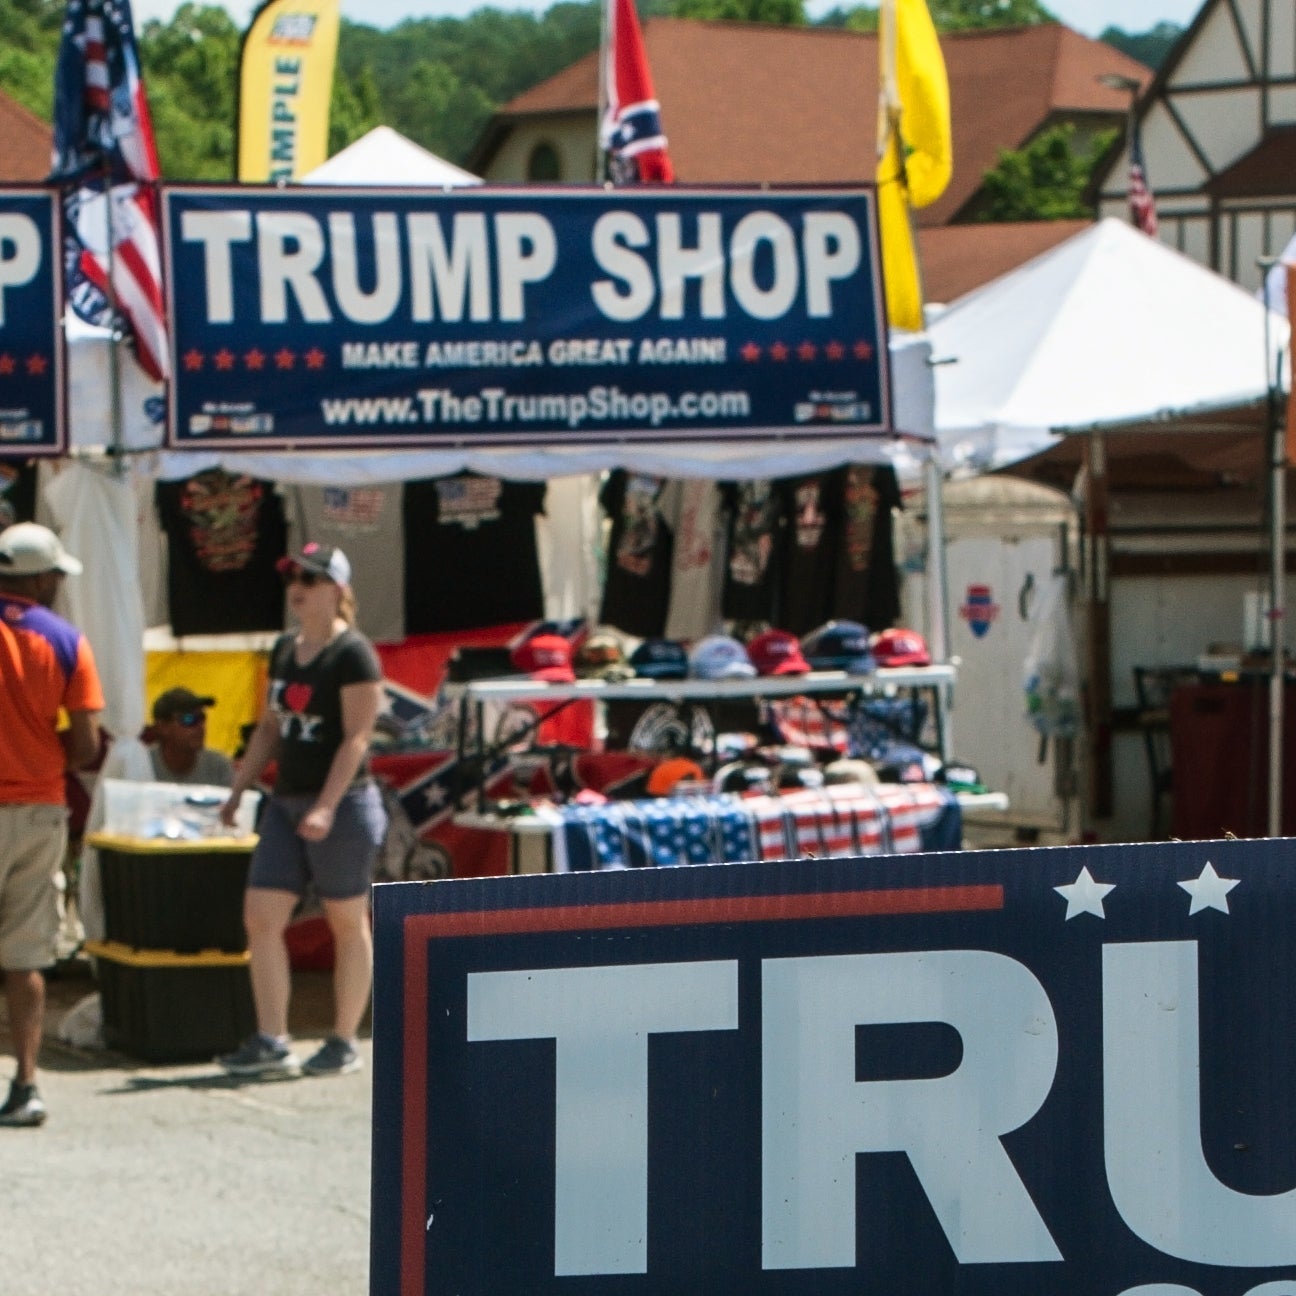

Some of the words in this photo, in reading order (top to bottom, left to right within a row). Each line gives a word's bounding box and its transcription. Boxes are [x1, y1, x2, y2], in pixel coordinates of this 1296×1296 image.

[181, 210, 558, 325] TRUMP
[591, 210, 862, 322] SHOP
[341, 341, 418, 369] MAKE
[425, 341, 544, 367] AMERICA
[548, 339, 630, 366] GREAT
[638, 337, 727, 364] AGAIN!
[321, 387, 750, 427] www.TheTrumpShop.com
